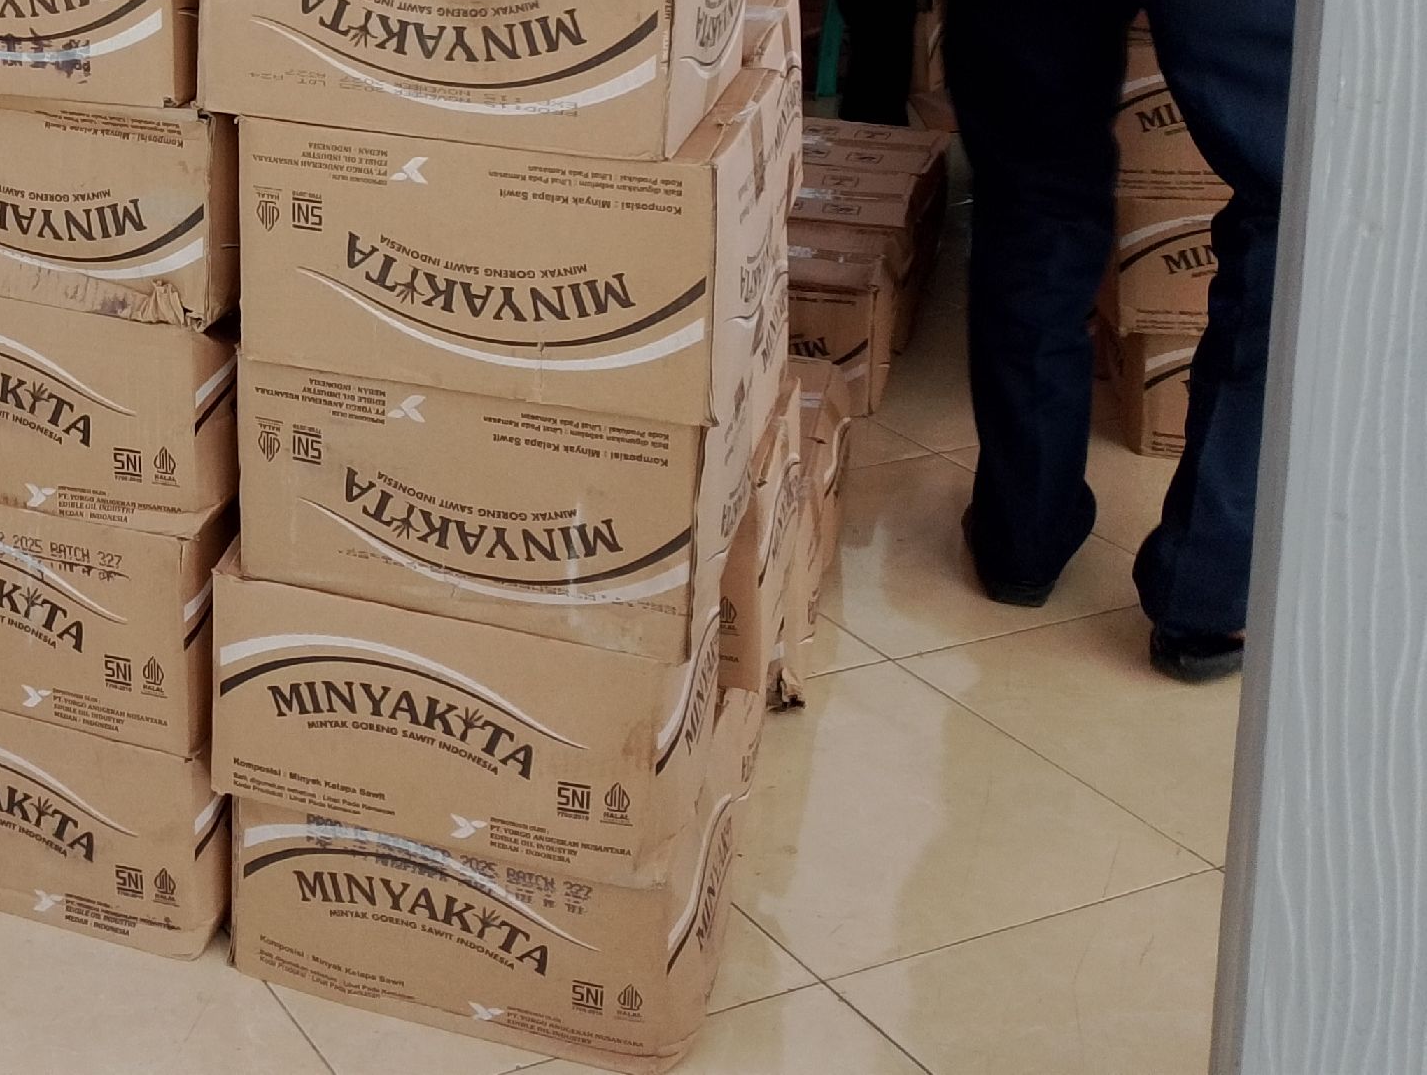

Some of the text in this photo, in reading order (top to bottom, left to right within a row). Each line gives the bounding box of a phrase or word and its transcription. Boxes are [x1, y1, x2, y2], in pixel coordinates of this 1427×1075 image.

[396, 1, 433, 15] SAWIT
[436, 7, 488, 18] GORENG
[492, 0, 539, 17] MINYAK
[29, 191, 70, 203] GORENG
[73, 190, 110, 202] MINYAK
[498, 189, 682, 215] Komposisi Minyak Kelapa Sawit
[292, 202, 322, 226] SNI
[380, 233, 588, 279] MINYAK GORENG SAWIT INDONESIA
[11, 413, 61, 444] INDONESIA
[292, 435, 322, 459] SNI
[492, 433, 668, 467] Komposisi Minyak Kelapa Sawit
[112, 451, 141, 472] SNI
[377, 470, 577, 521] MINYAK GORENG SAWIT INDONESIA
[13, 533, 43, 553] 2025
[97, 551, 122, 570] 327
[7, 616, 55, 648] INDONESIA
[104, 658, 131, 681] SNI
[306, 718, 497, 774] MINYAK GORENG SAWIT INDONESIA
[232, 755, 384, 801] Komposisi Minyak Kelapa Sawit
[556, 785, 590, 809] SNI
[18, 824, 66, 857] INDONESIA
[115, 868, 143, 890] SNI
[329, 908, 513, 970] MINYAK GORENG SAWIT INDONESIA
[570, 983, 604, 1005] SNI
